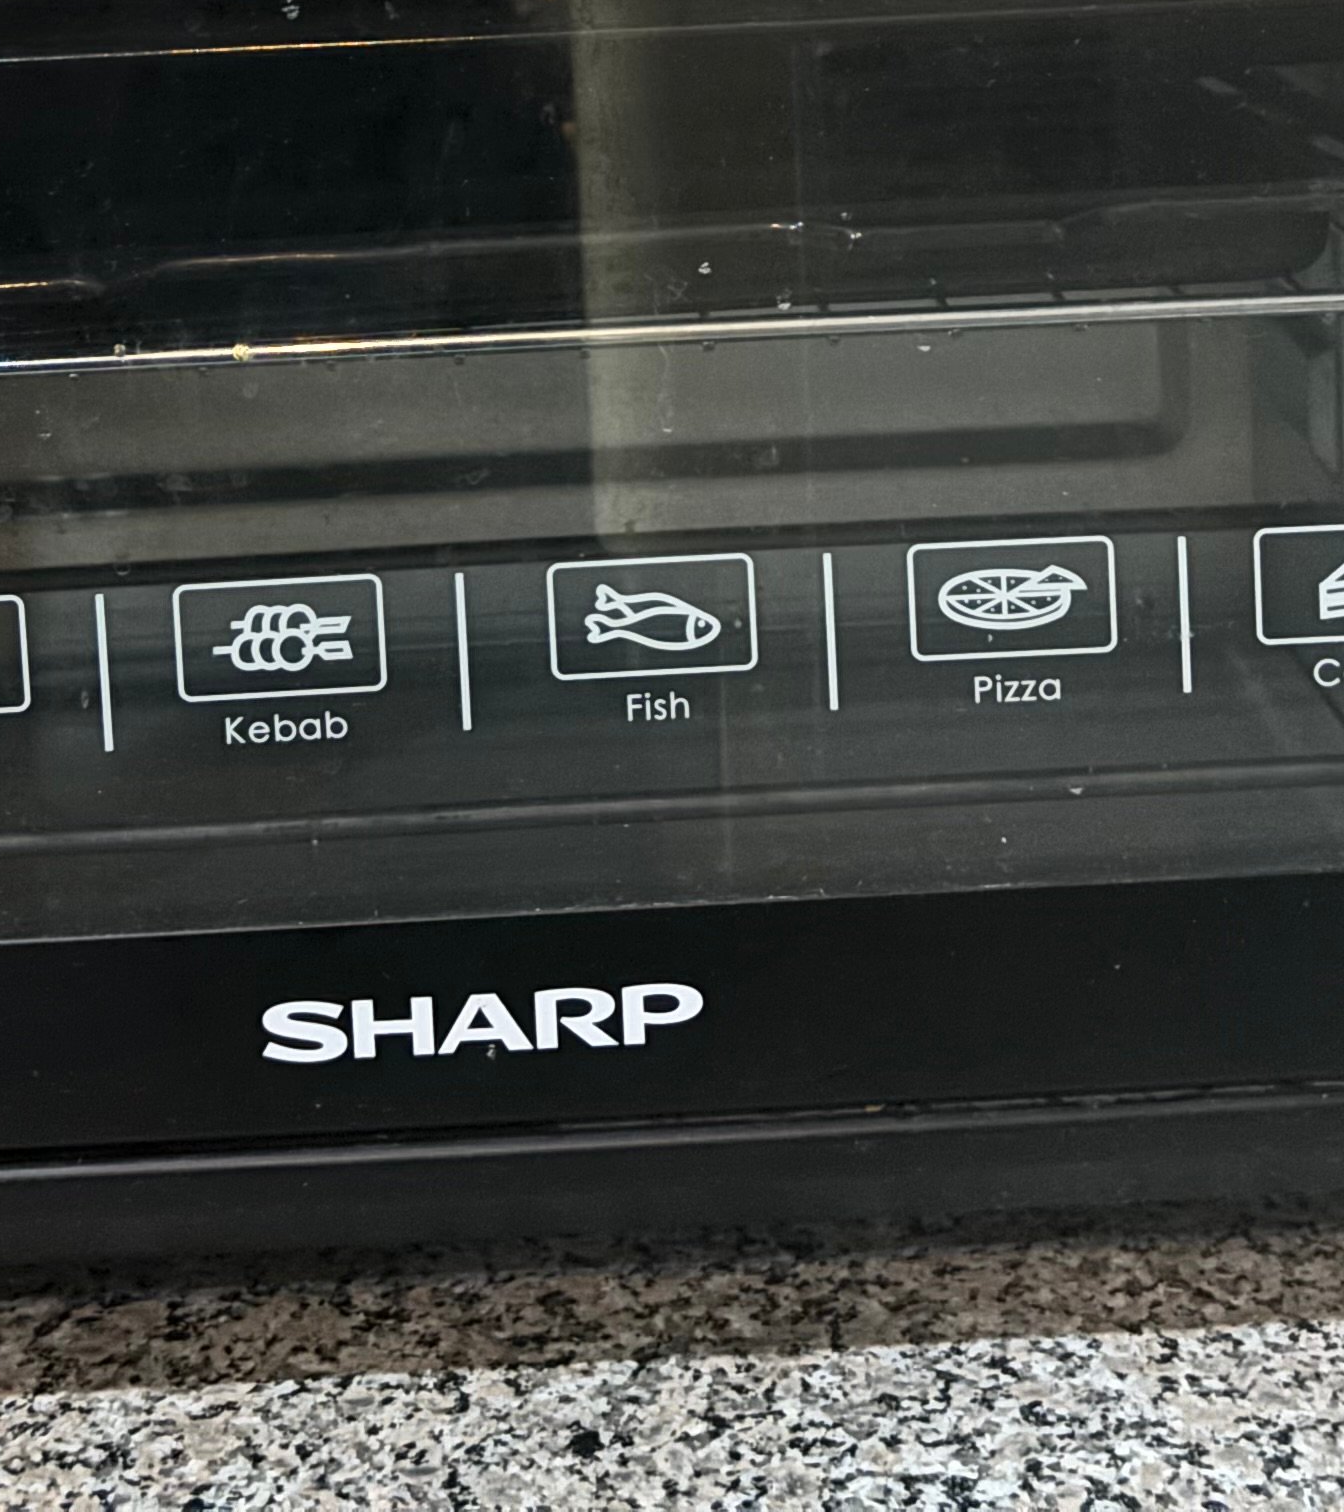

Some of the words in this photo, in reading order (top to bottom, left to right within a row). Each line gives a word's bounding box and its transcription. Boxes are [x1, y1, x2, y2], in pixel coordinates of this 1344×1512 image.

[973, 674, 1061, 704] Pizza
[626, 691, 690, 722] Fish
[225, 710, 348, 745] Kebab
[262, 983, 704, 1063] SHARP
